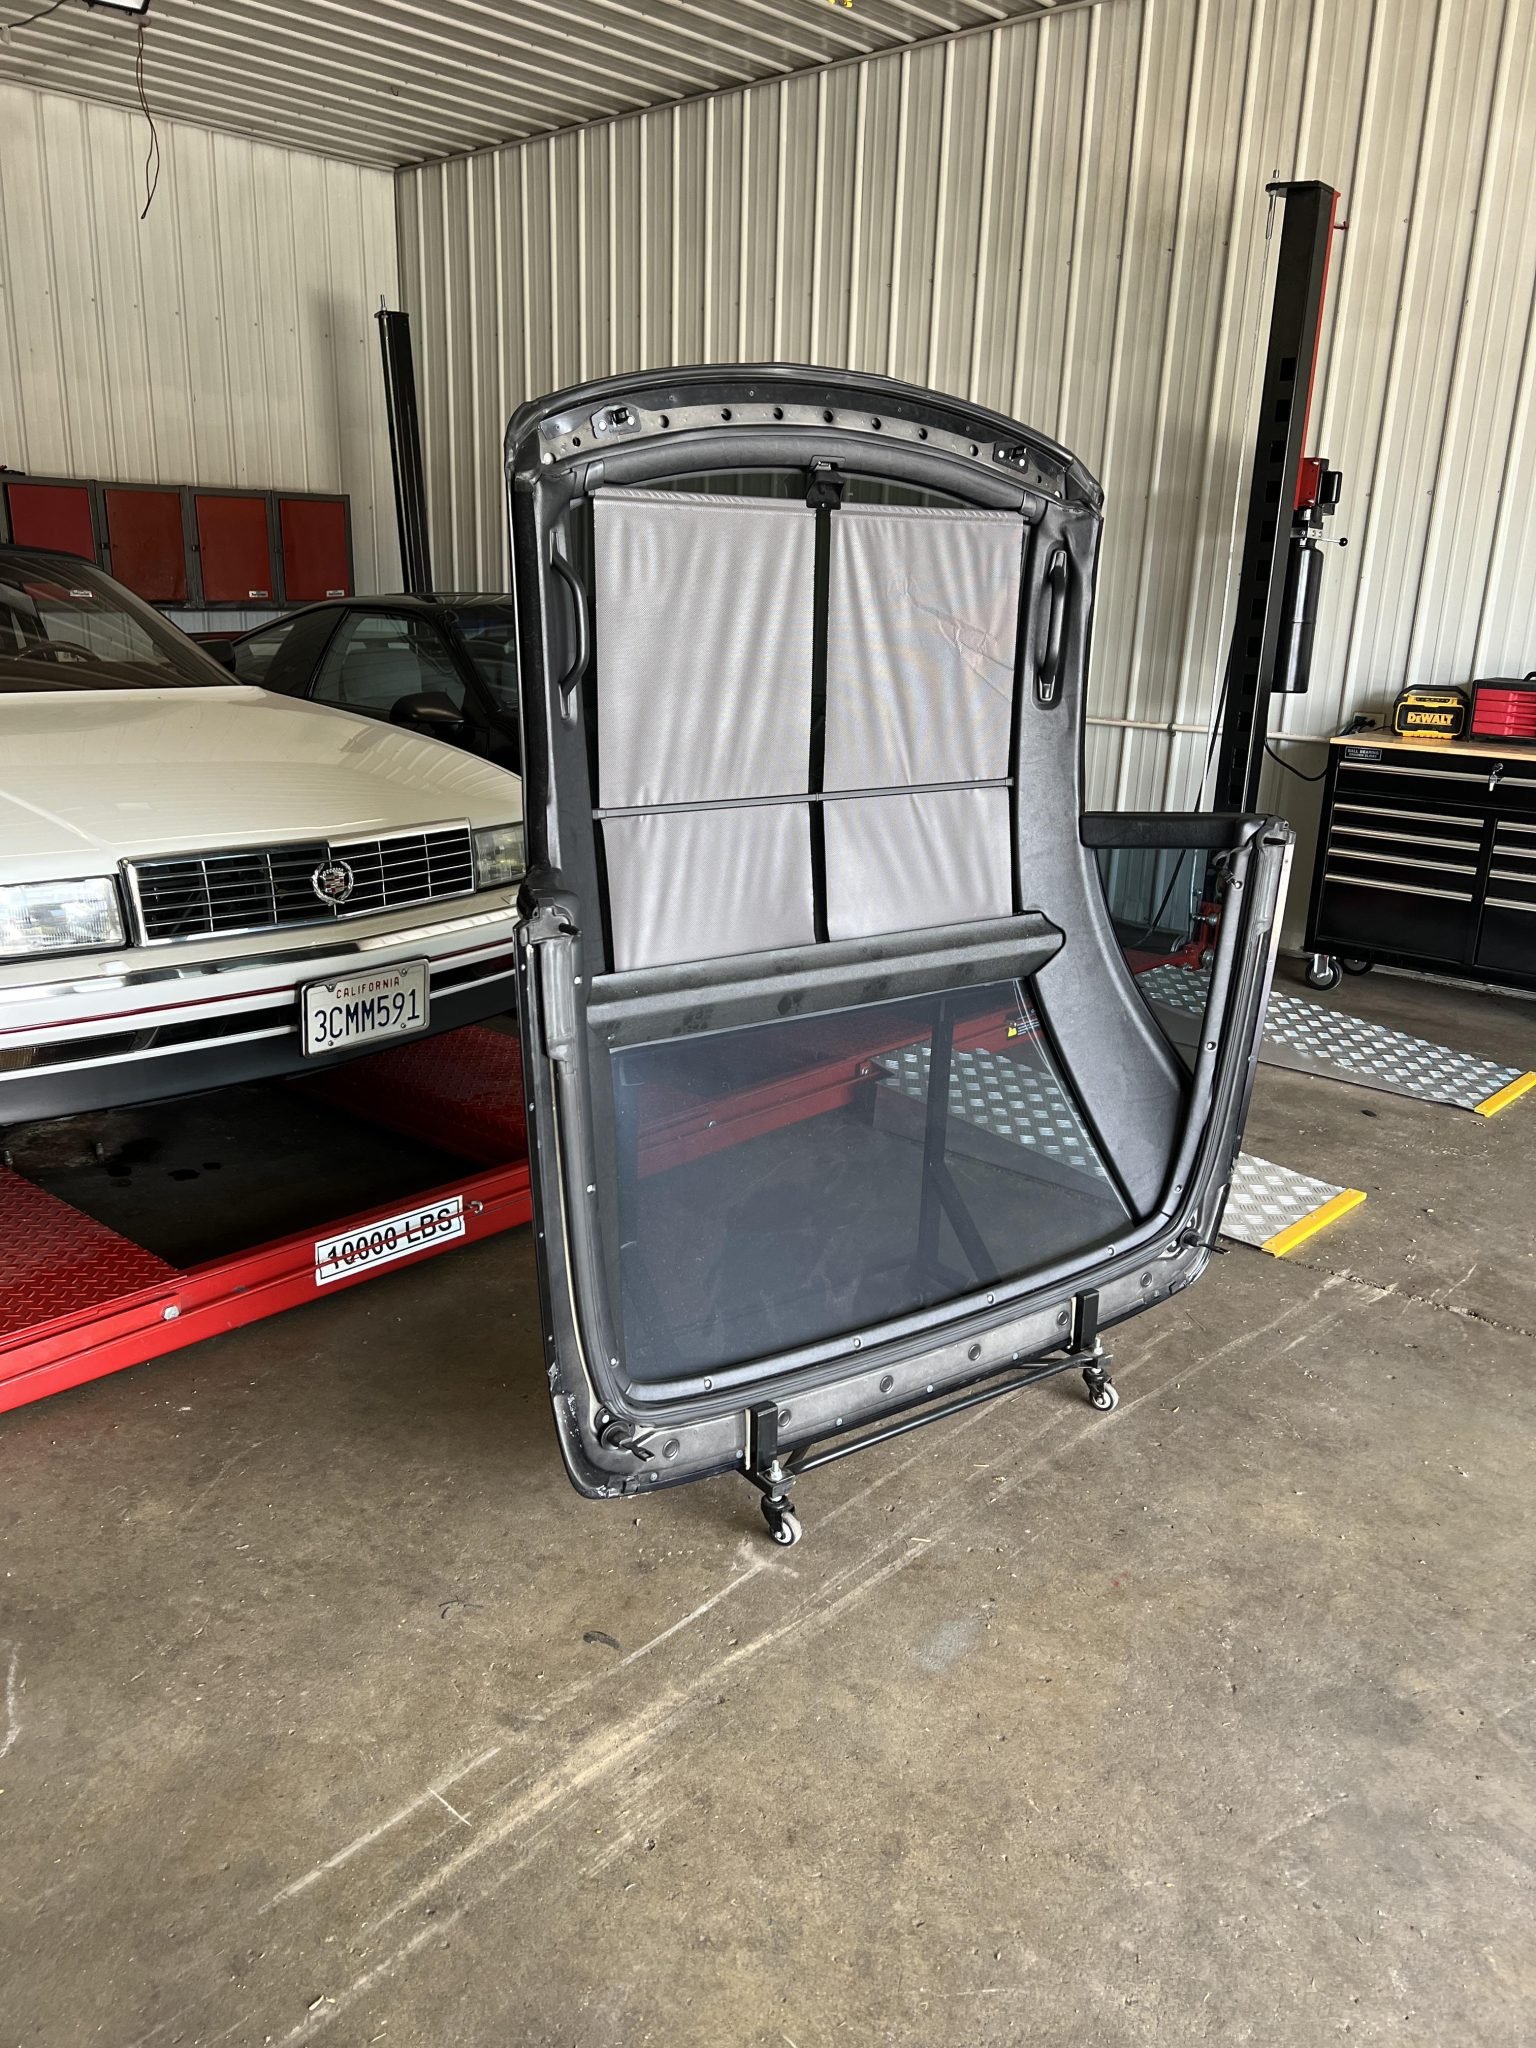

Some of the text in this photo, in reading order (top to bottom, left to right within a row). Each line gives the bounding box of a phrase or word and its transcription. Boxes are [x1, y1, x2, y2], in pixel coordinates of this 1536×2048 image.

[336, 976, 400, 999] CALIFORNIA
[314, 988, 420, 1043] 3CMM591
[327, 1207, 453, 1270] 10000 LBS
